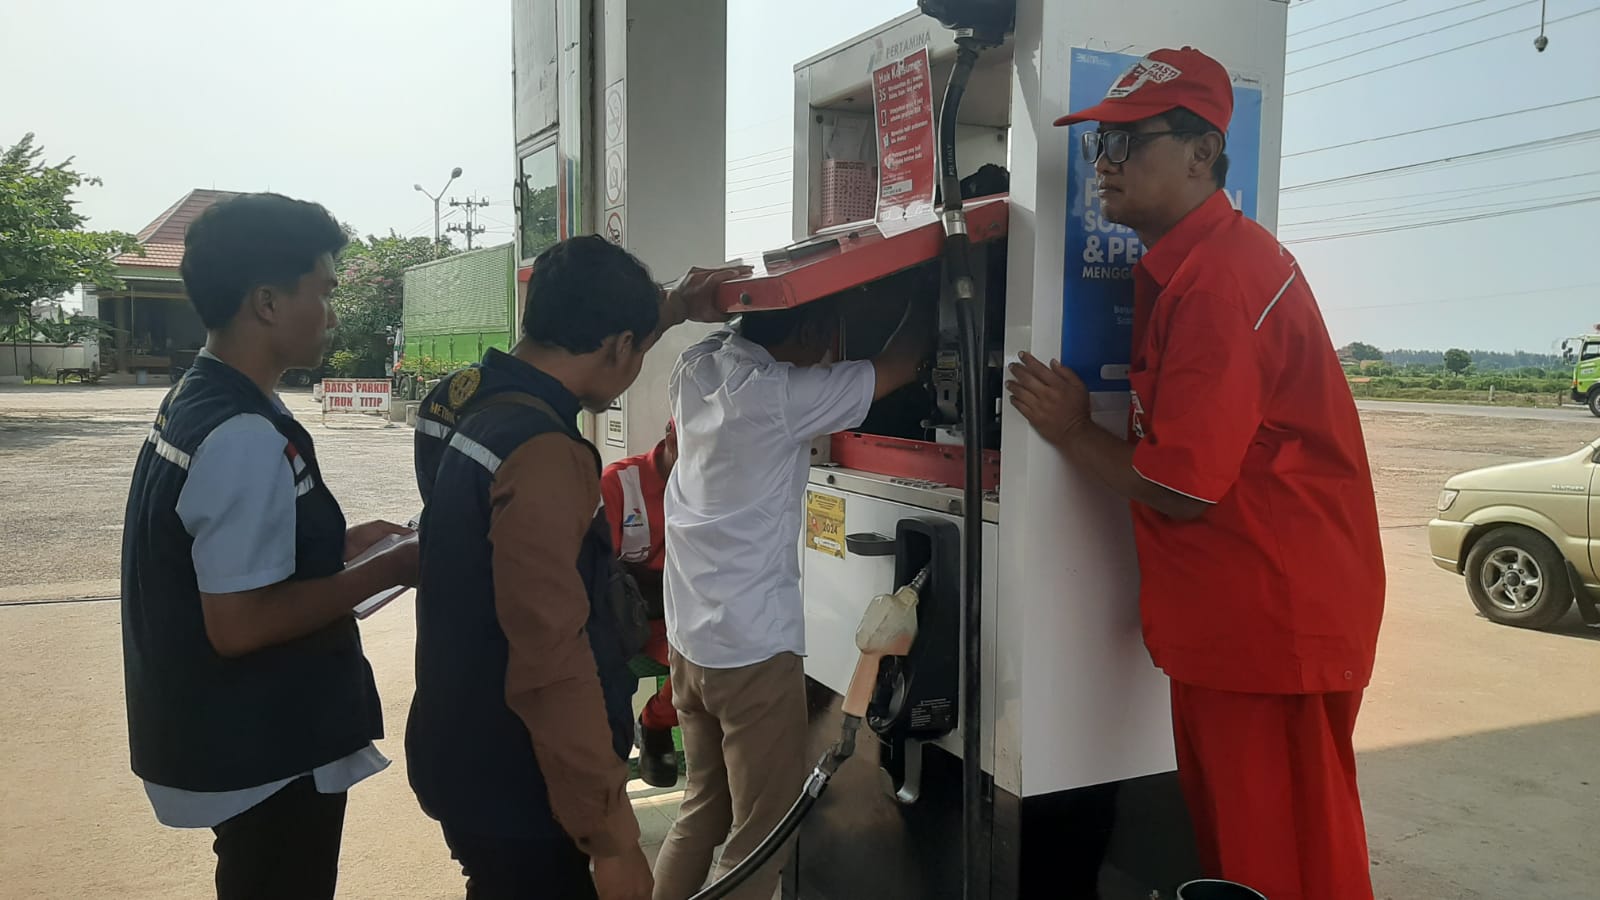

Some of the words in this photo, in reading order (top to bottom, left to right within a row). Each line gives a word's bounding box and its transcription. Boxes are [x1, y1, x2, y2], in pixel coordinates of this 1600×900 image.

[886, 32, 931, 59] PERTAMINA
[1151, 63, 1178, 78] PASTI
[1083, 235, 1105, 264] &
[1082, 265, 1134, 280] MENGG
[324, 382, 353, 393] BATAS
[356, 383, 389, 393] PARKIR
[329, 396, 353, 407] TRUK
[359, 397, 383, 407] TITIP
[823, 522, 838, 535] 2024
